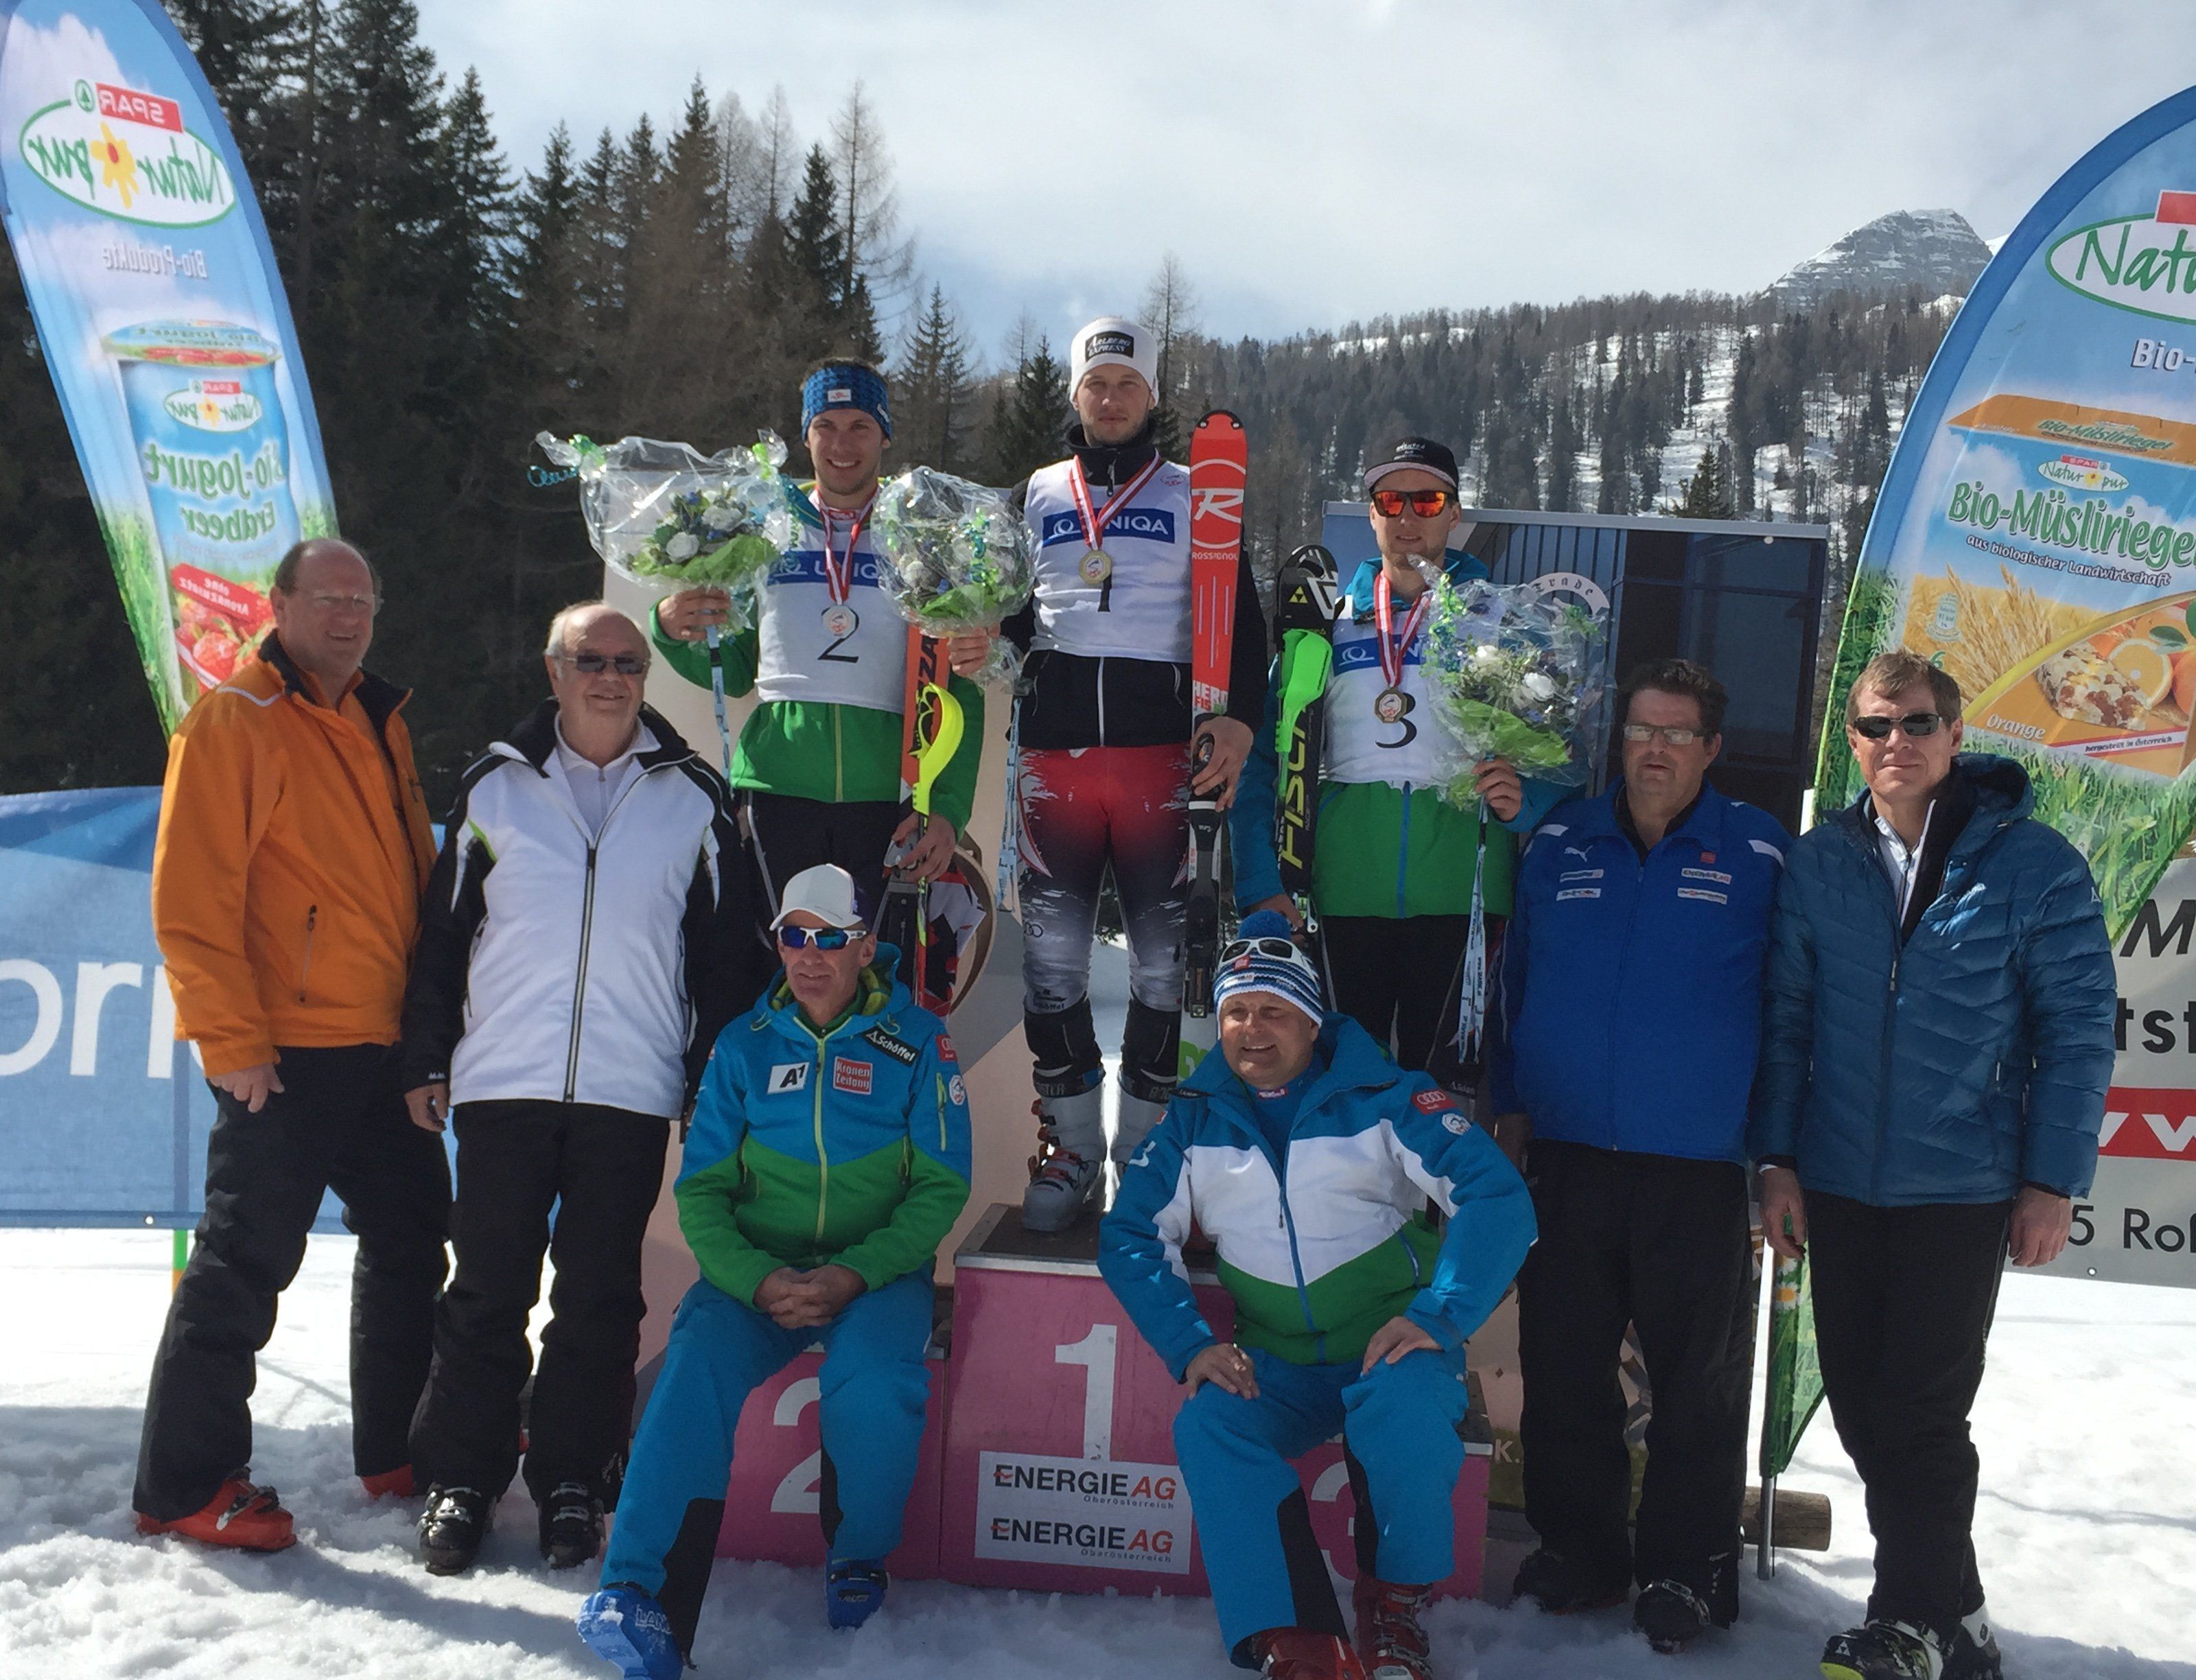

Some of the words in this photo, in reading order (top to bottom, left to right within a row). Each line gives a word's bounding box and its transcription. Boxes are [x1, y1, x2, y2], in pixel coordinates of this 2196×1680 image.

[2130, 338, 2196, 374] Bio-
[2037, 419, 2174, 451] Bio-Müsliriegel
[2043, 462, 2083, 482] Natur
[2102, 476, 2127, 491] pur
[2069, 457, 2098, 469] SPAR
[1105, 515, 1169, 536] NIQA
[1948, 480, 2196, 571] Bio-Müsliriege
[1967, 533, 1989, 551] aus
[1990, 541, 2066, 572] biologischer
[2068, 559, 2173, 587] Landwirtschaft
[1532, 576, 1593, 596] Trade
[817, 606, 861, 664] 2
[1375, 692, 1417, 749] 3
[1987, 714, 2046, 741] Orange
[876, 1035, 916, 1062] Schöffel
[780, 1064, 807, 1088] A1
[836, 1061, 871, 1077] Kronen
[1055, 1324, 1118, 1462] 1
[771, 1377, 822, 1515] 2
